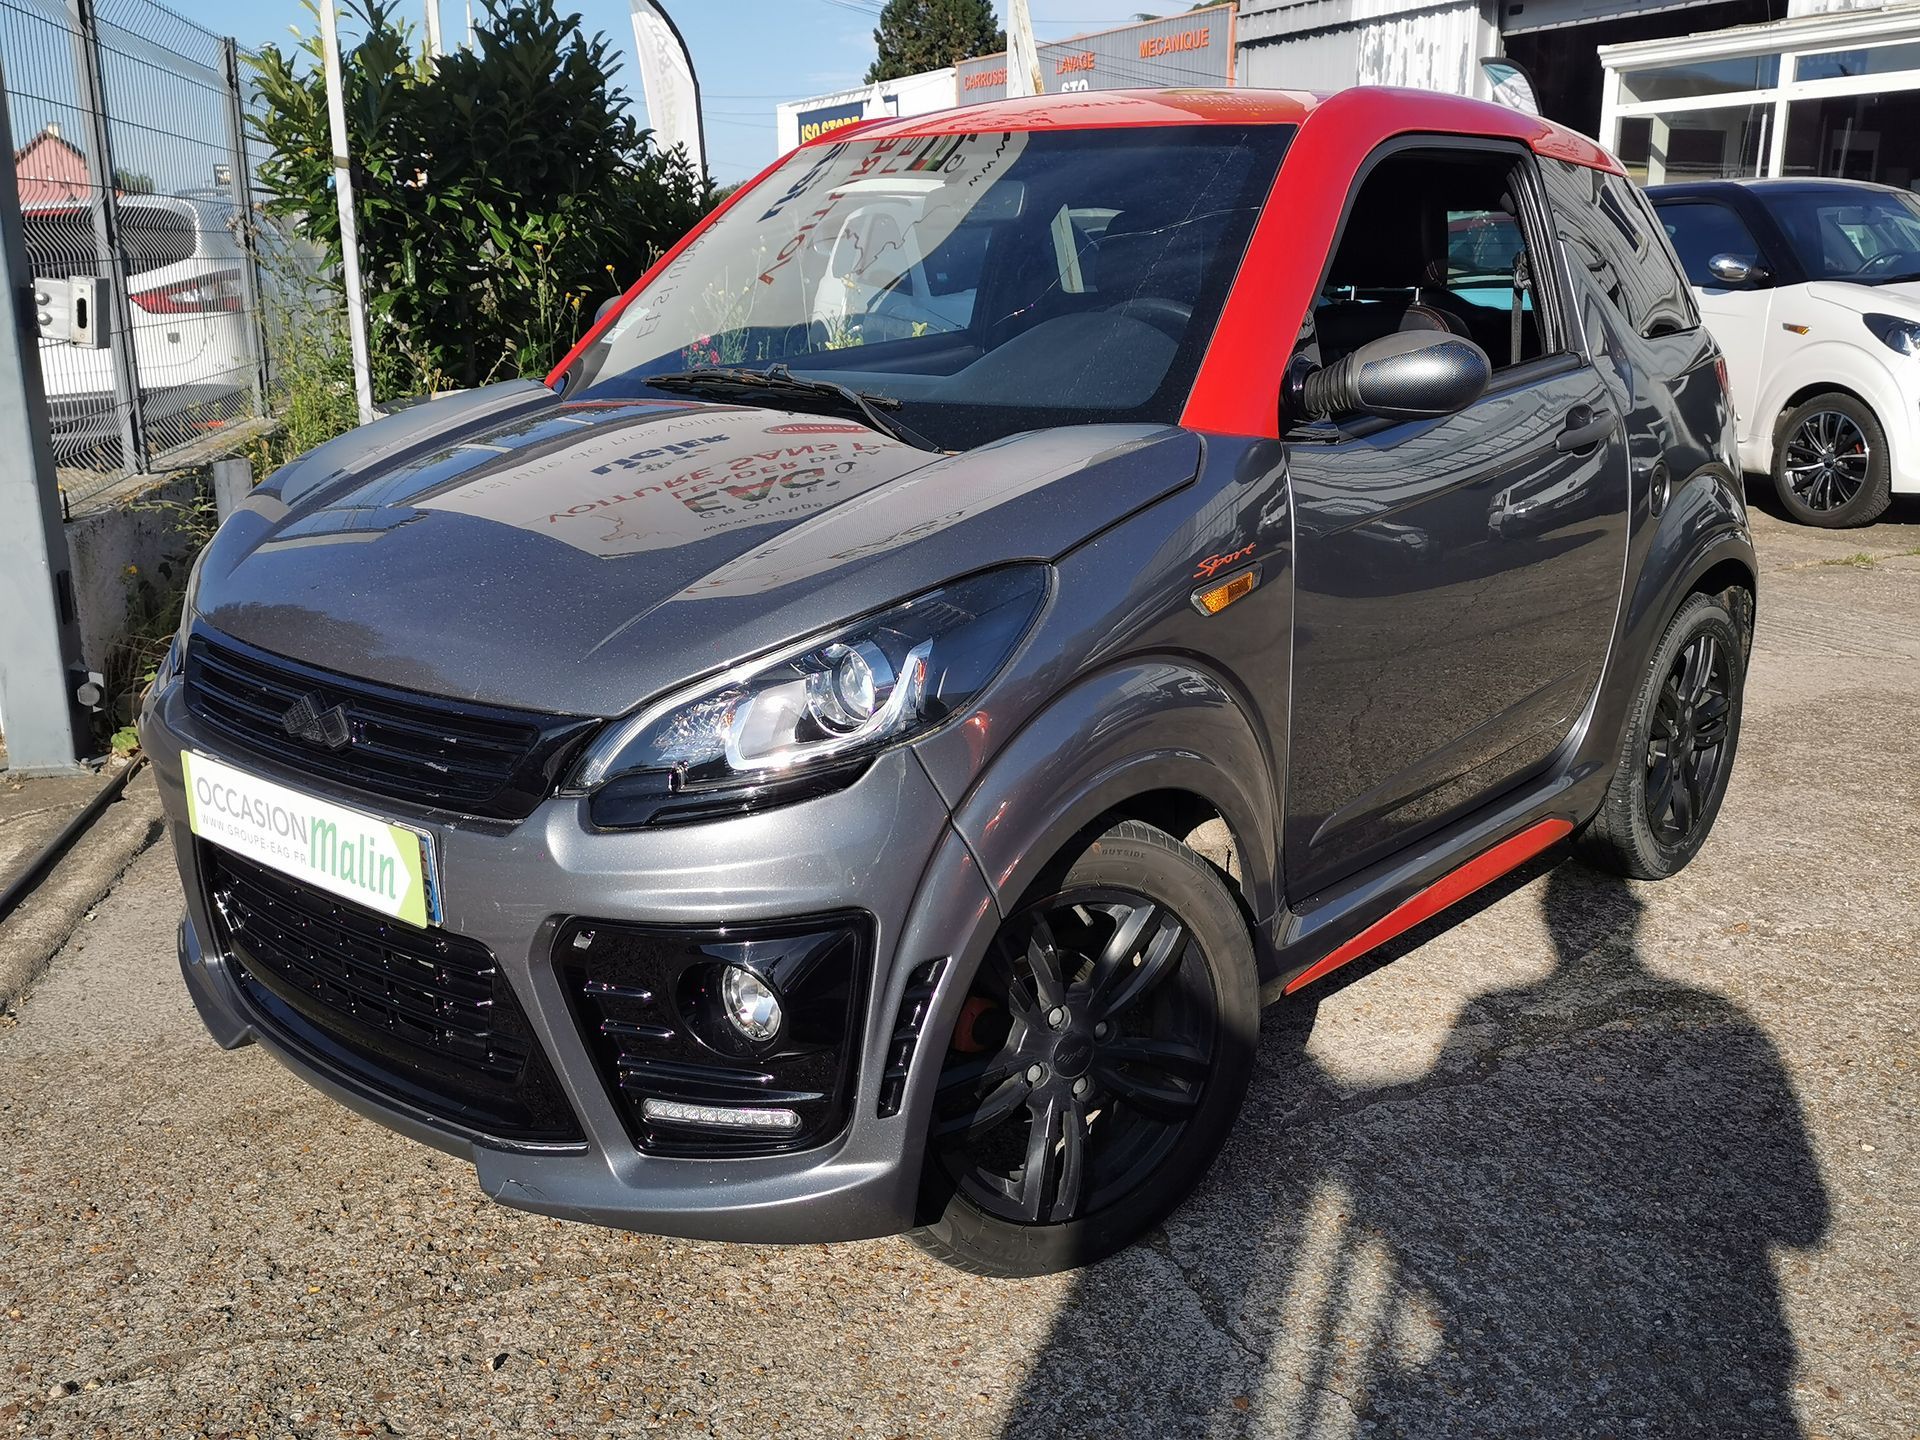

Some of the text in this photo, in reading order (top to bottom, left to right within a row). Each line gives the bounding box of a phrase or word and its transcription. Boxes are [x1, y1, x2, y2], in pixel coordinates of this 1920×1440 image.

[1138, 27, 1210, 59] MECANIQUE
[1055, 51, 1096, 75] LAVAGE
[1192, 541, 1257, 578] Sport
[196, 777, 308, 844] OCCASION
[201, 814, 307, 866] WWW.GROUPE-EAG.FR
